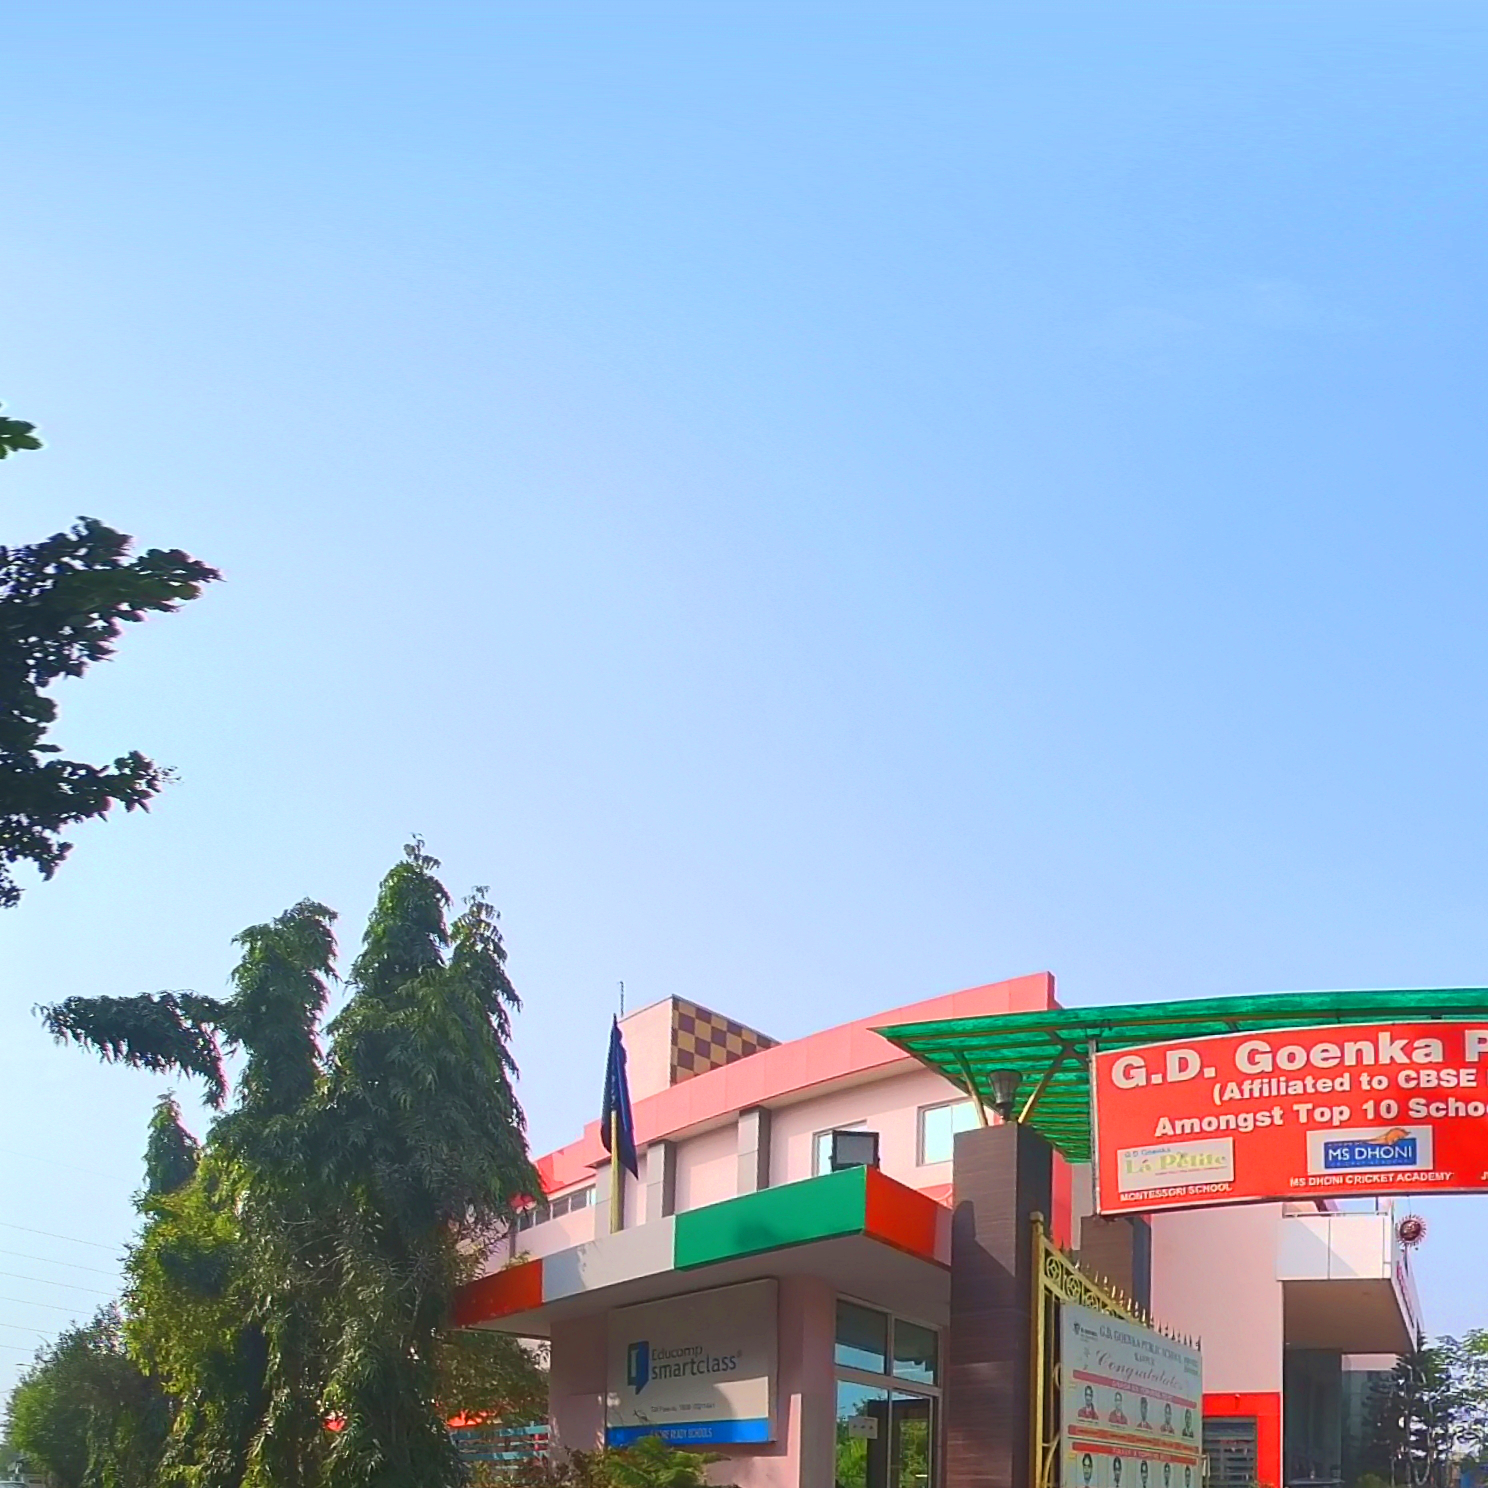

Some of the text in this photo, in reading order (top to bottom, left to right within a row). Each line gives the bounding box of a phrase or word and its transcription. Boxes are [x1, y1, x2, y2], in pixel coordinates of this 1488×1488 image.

[1111, 1049, 1216, 1090] G.D.
[1235, 1031, 1444, 1075] Goenka
[1213, 1072, 1351, 1105] (Affiliated
[1360, 1072, 1389, 1090] to
[1398, 1068, 1476, 1088] CBSE
[1155, 1106, 1283, 1137] Amongst
[1293, 1103, 1350, 1126] Top
[1361, 1099, 1398, 1120] 10
[1328, 1146, 1412, 1161] MS DHONI
[1290, 1172, 1452, 1187] MS DHONI CRICKET ACADEMY
[1120, 1183, 1233, 1202] MONTESSORI SCHOOL
[652, 1346, 703, 1361] Educomp
